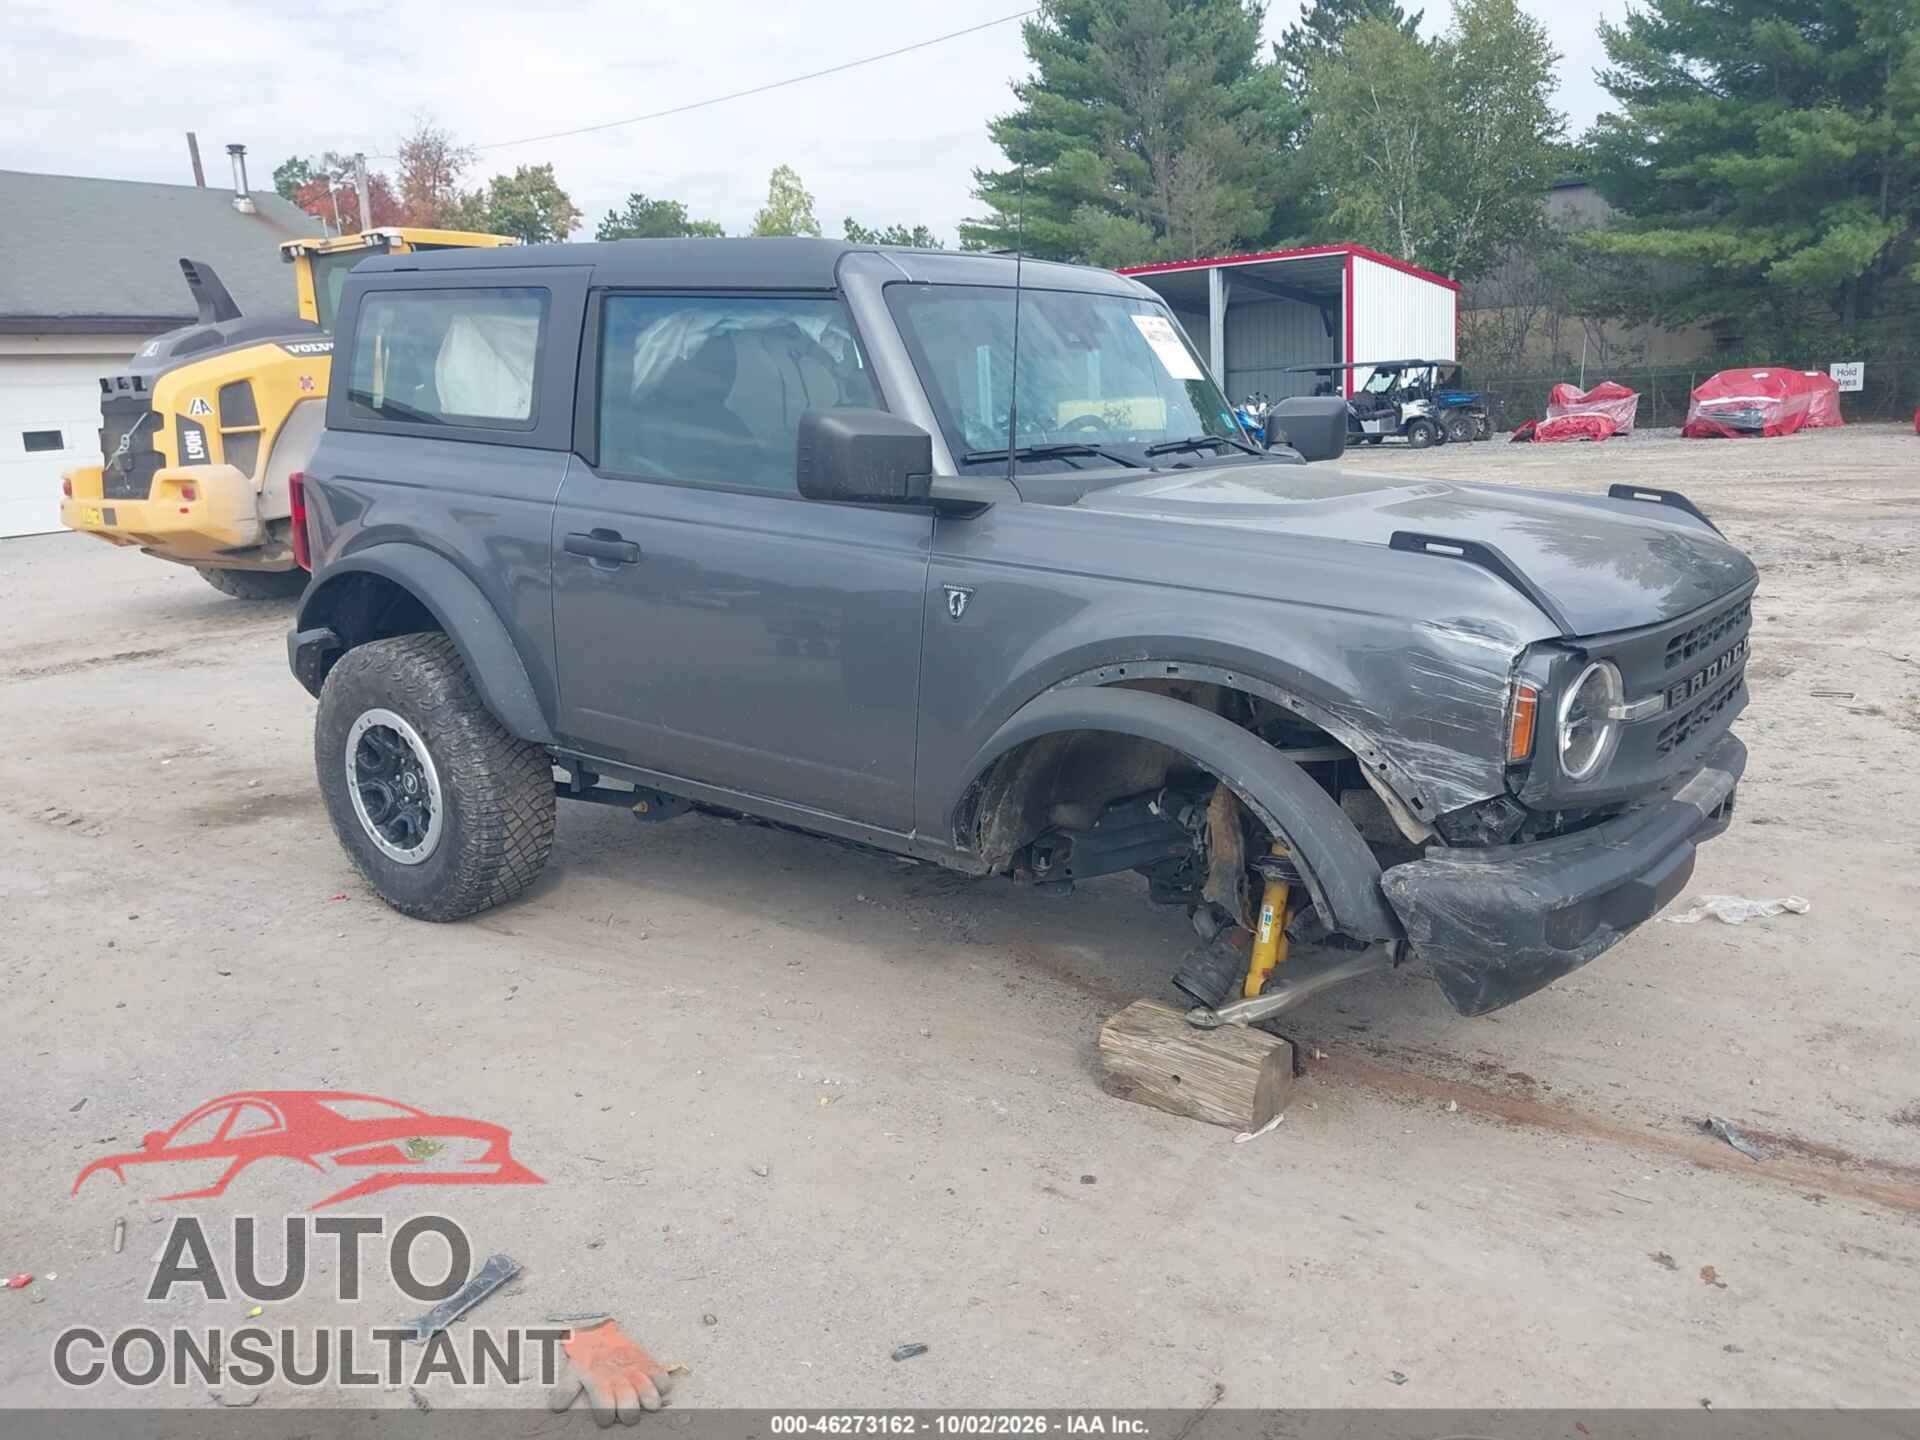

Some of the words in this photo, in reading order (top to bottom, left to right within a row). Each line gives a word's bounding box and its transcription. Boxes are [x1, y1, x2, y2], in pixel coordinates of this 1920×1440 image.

[285, 342, 335, 353] VOLV
[1837, 368, 1857, 376] Hold
[183, 430, 205, 460] L90H
